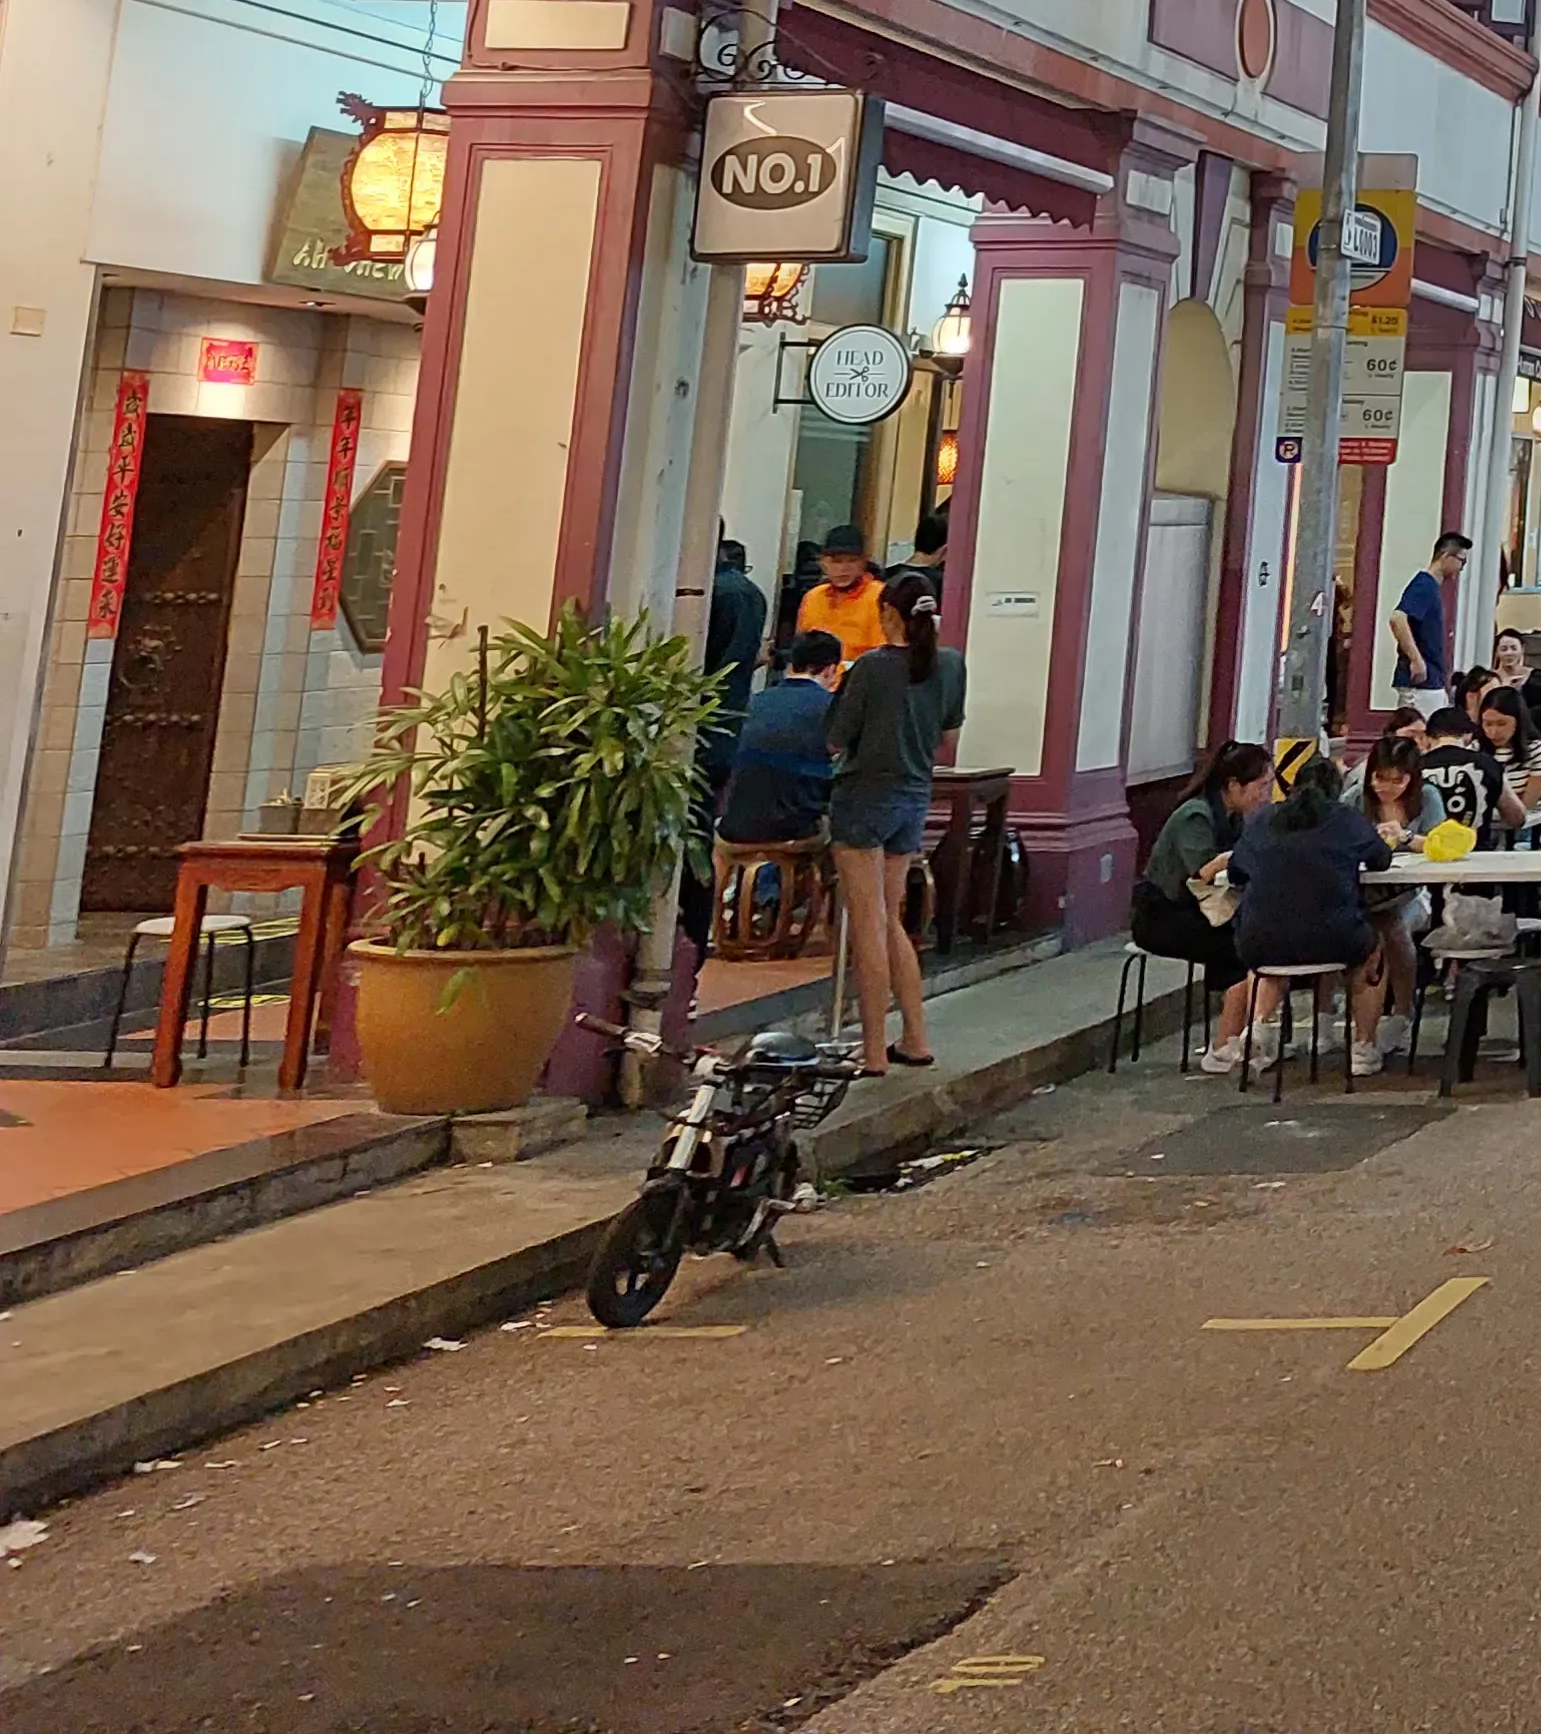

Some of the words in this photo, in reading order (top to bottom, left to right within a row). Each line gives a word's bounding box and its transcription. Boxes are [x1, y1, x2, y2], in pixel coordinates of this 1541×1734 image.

[721, 152, 823, 196] NO.1
[836, 350, 884, 366] HEAD
[1366, 358, 1398, 372] 60¢
[825, 382, 889, 399] EDITOR
[1362, 409, 1394, 422] 60¢
